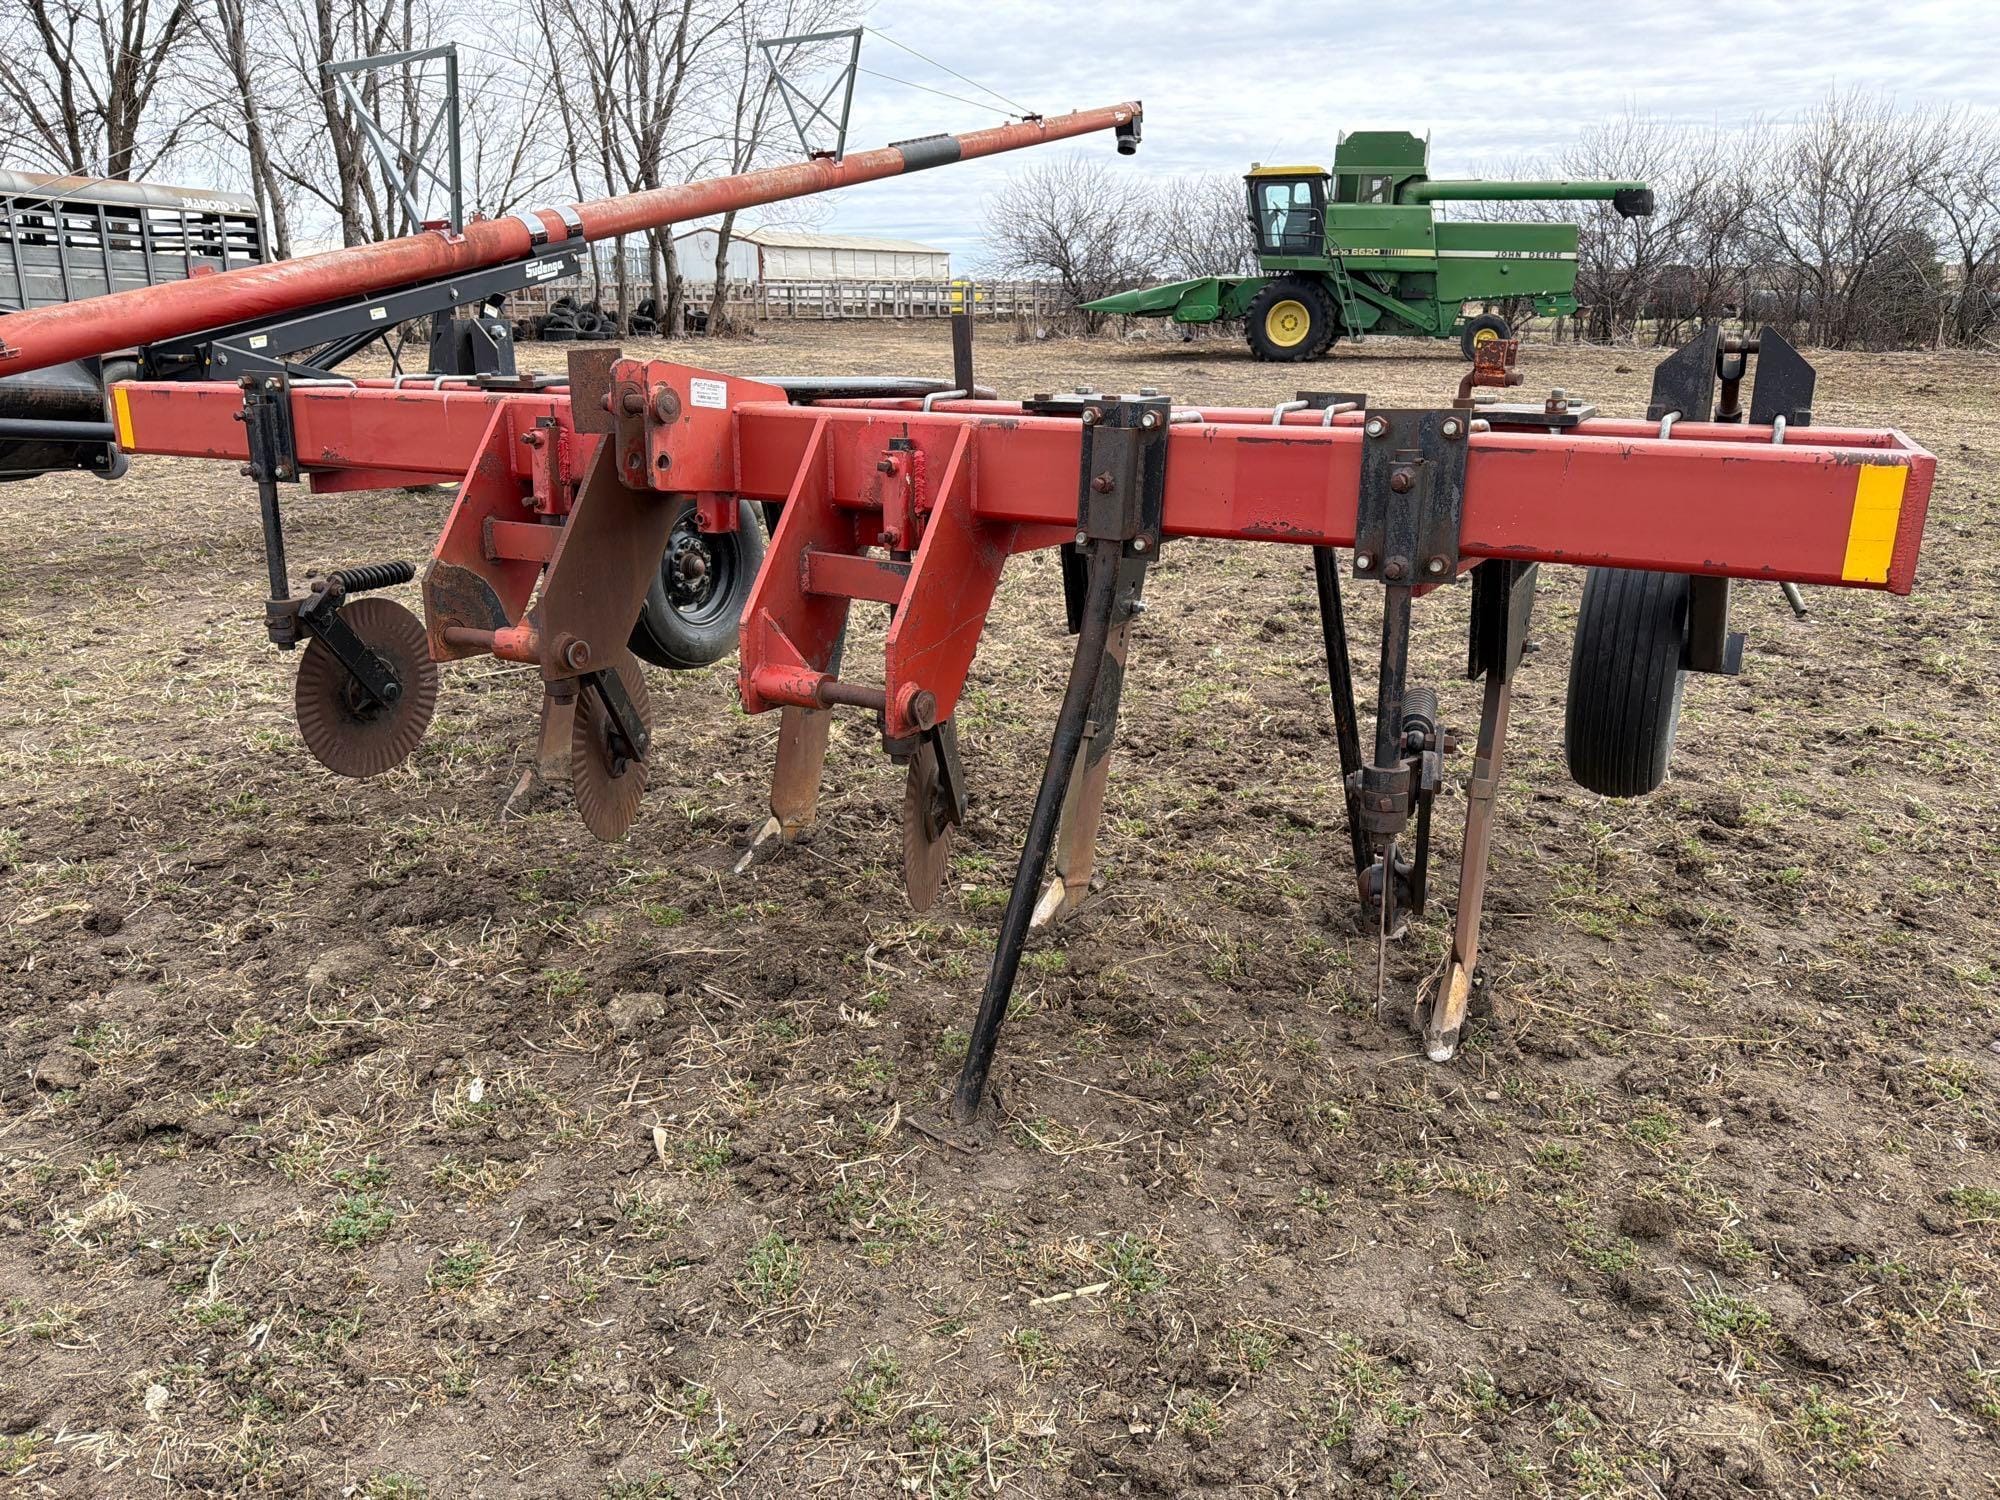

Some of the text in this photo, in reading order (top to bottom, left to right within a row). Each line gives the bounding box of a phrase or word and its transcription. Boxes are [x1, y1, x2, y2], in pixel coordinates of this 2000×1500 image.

[1351, 248, 1380, 256] 6620
[1495, 250, 1562, 259] JOHN DEERE
[525, 260, 564, 280] Sudenga
